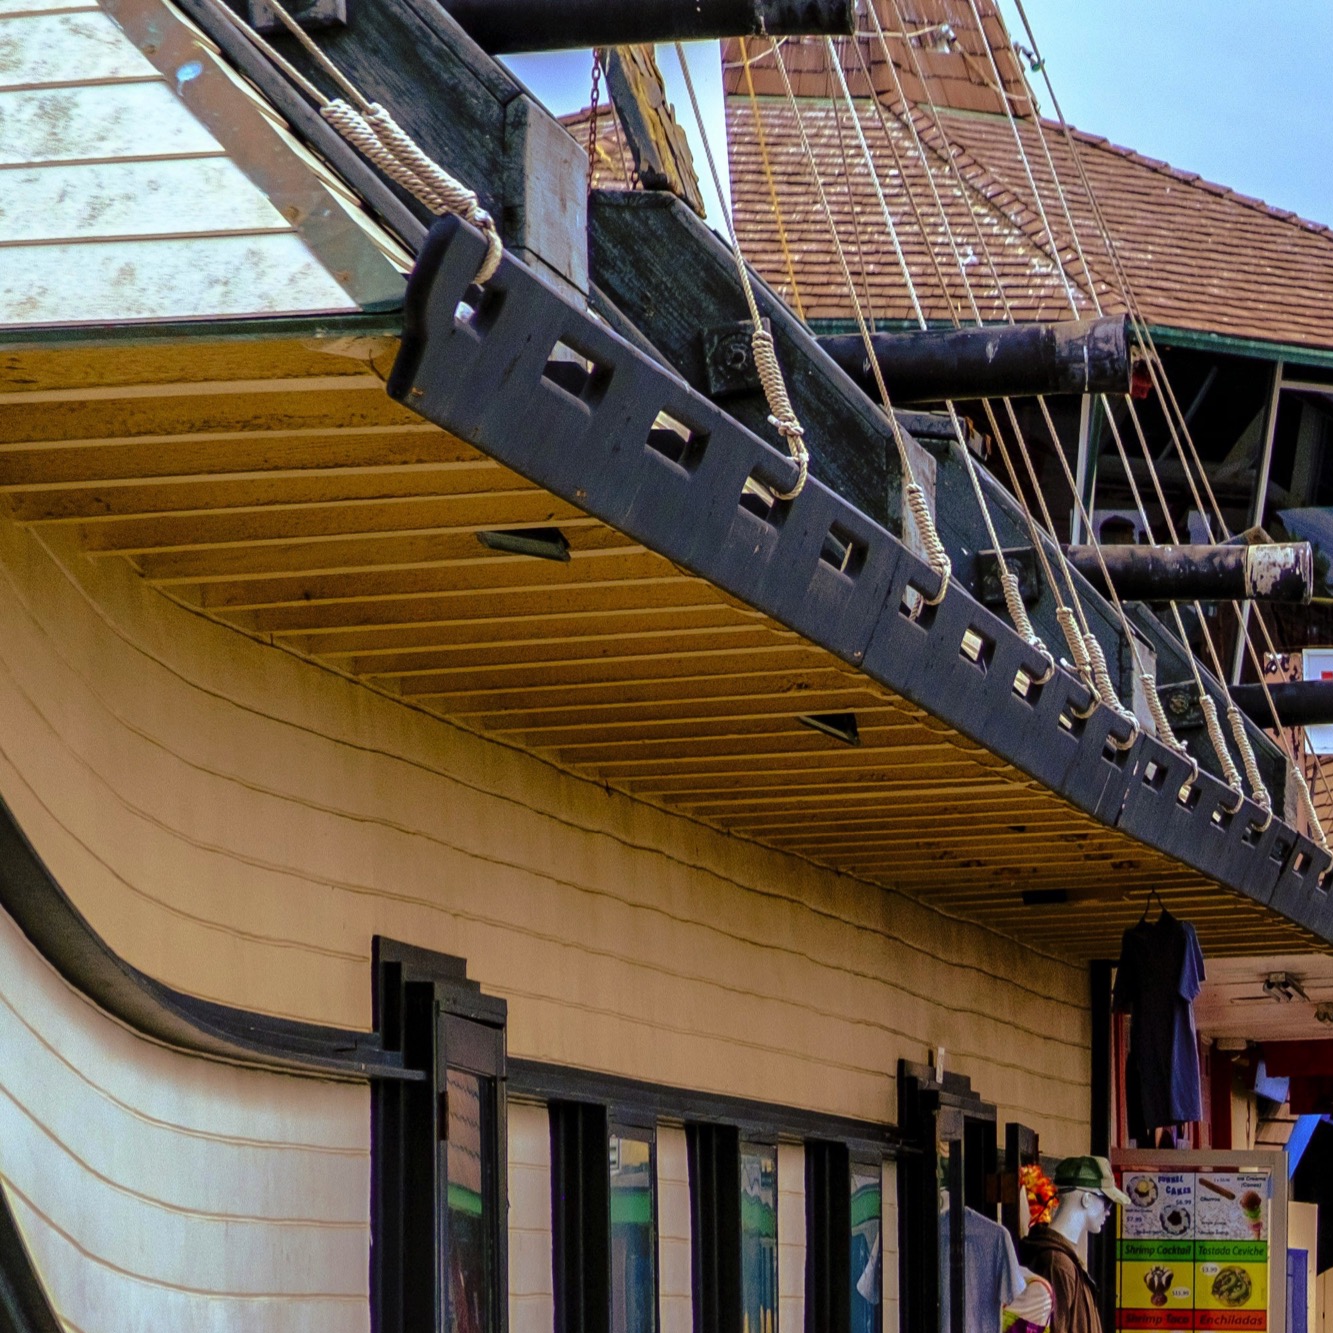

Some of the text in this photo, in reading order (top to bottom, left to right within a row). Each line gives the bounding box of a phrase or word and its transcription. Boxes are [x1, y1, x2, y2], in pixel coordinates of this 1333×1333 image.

[1165, 1186, 1192, 1196] CAKES
[1125, 1244, 1192, 1257] Shrimp Cocktail
[1198, 1245, 1264, 1256] Tostada Ceviche
[1125, 1314, 1190, 1326] Shrimp Taco
[1199, 1314, 1263, 1326] Enchiladas
